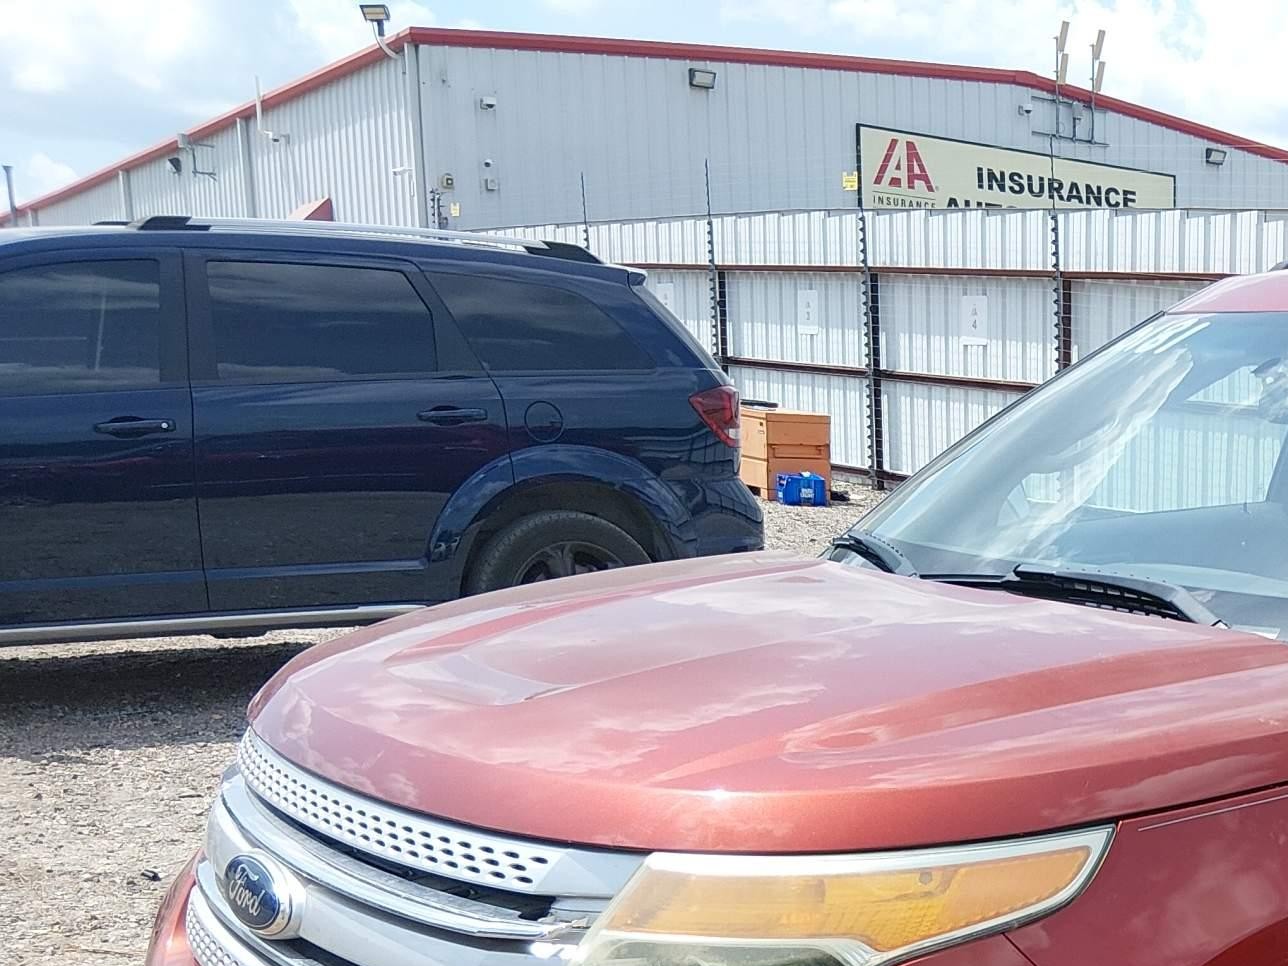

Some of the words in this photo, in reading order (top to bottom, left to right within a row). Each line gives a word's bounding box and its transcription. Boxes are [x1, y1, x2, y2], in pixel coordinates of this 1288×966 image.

[872, 195, 936, 209] INSURANCE
[976, 166, 1137, 209] INSURANCE
[228, 864, 266, 917] Ford
